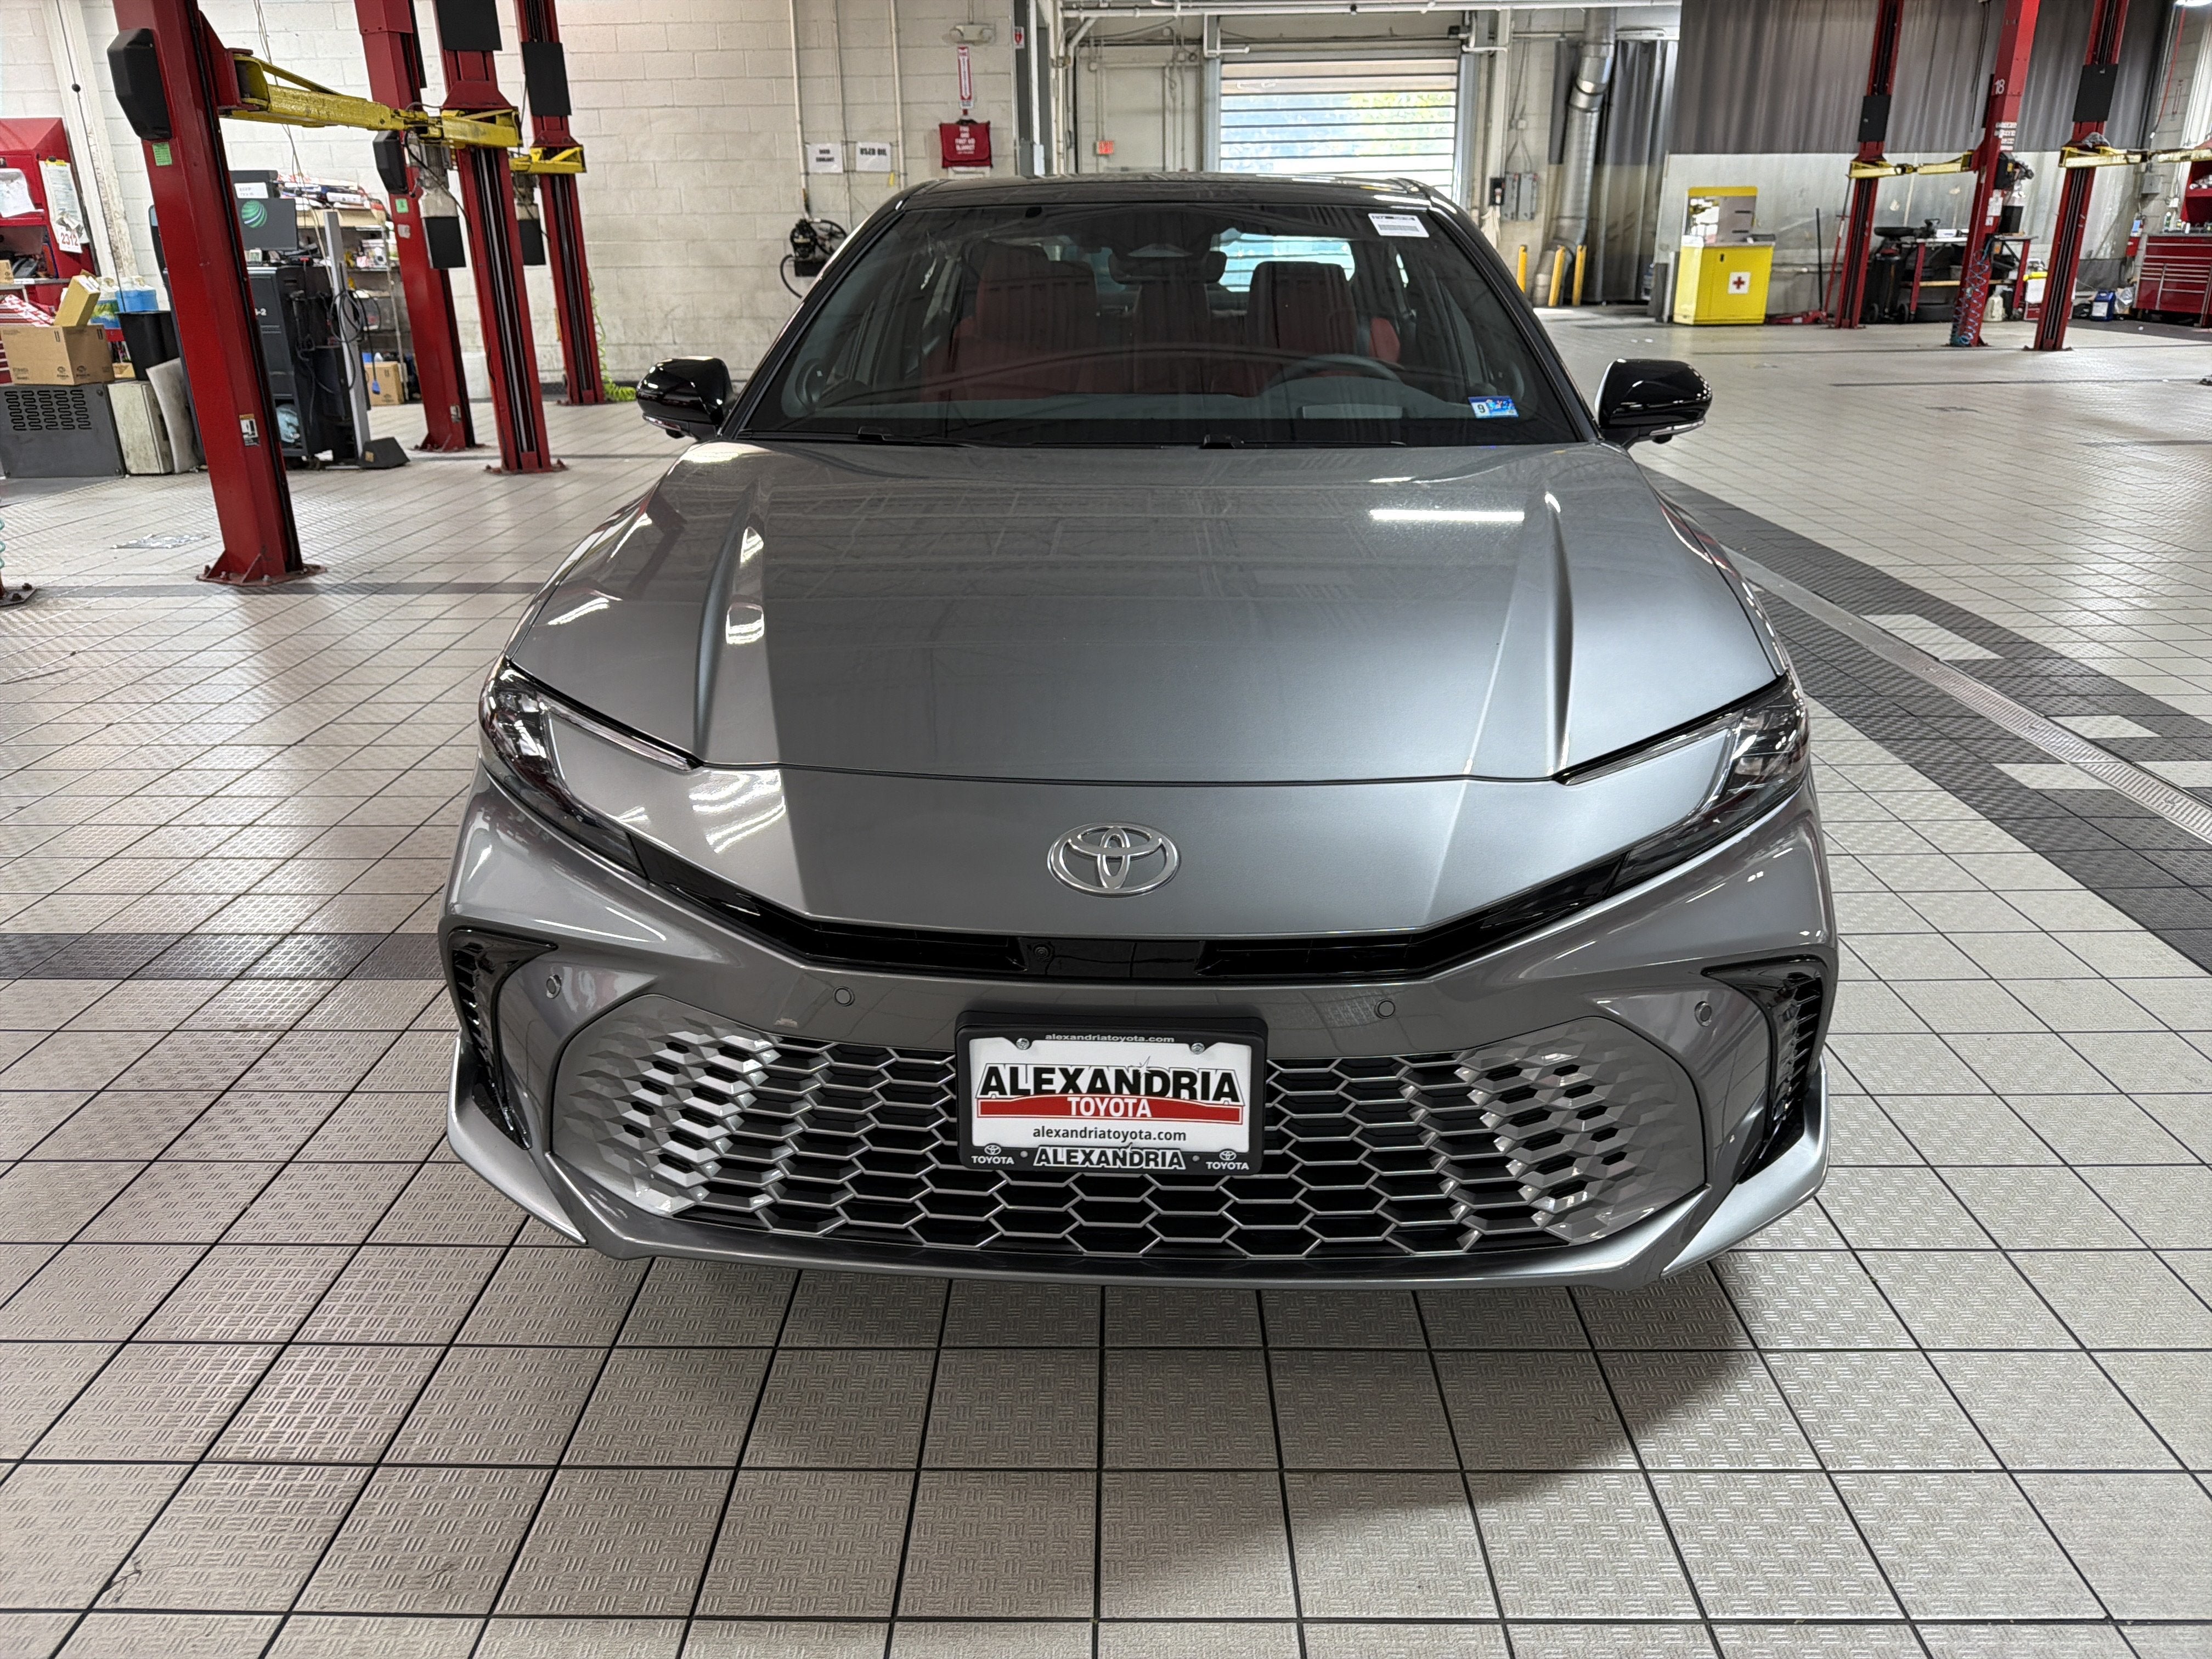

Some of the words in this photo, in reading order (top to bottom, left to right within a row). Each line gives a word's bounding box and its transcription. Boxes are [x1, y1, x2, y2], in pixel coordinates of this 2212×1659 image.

[1994, 79, 2005, 94] 18
[60, 232, 79, 246] 2312
[1477, 404, 1486, 413] 9
[1045, 1033, 1175, 1043] alexandriatoyota.com
[979, 1065, 1241, 1103] ALEXANDRIA
[1066, 1096, 1152, 1117] TOYOTA
[1032, 1125, 1187, 1143] alexandriatoyota.com
[970, 1155, 1015, 1165] TOYOTA
[1033, 1146, 1186, 1169] ALEXANDRIA
[1205, 1161, 1250, 1170] TOYOTA
